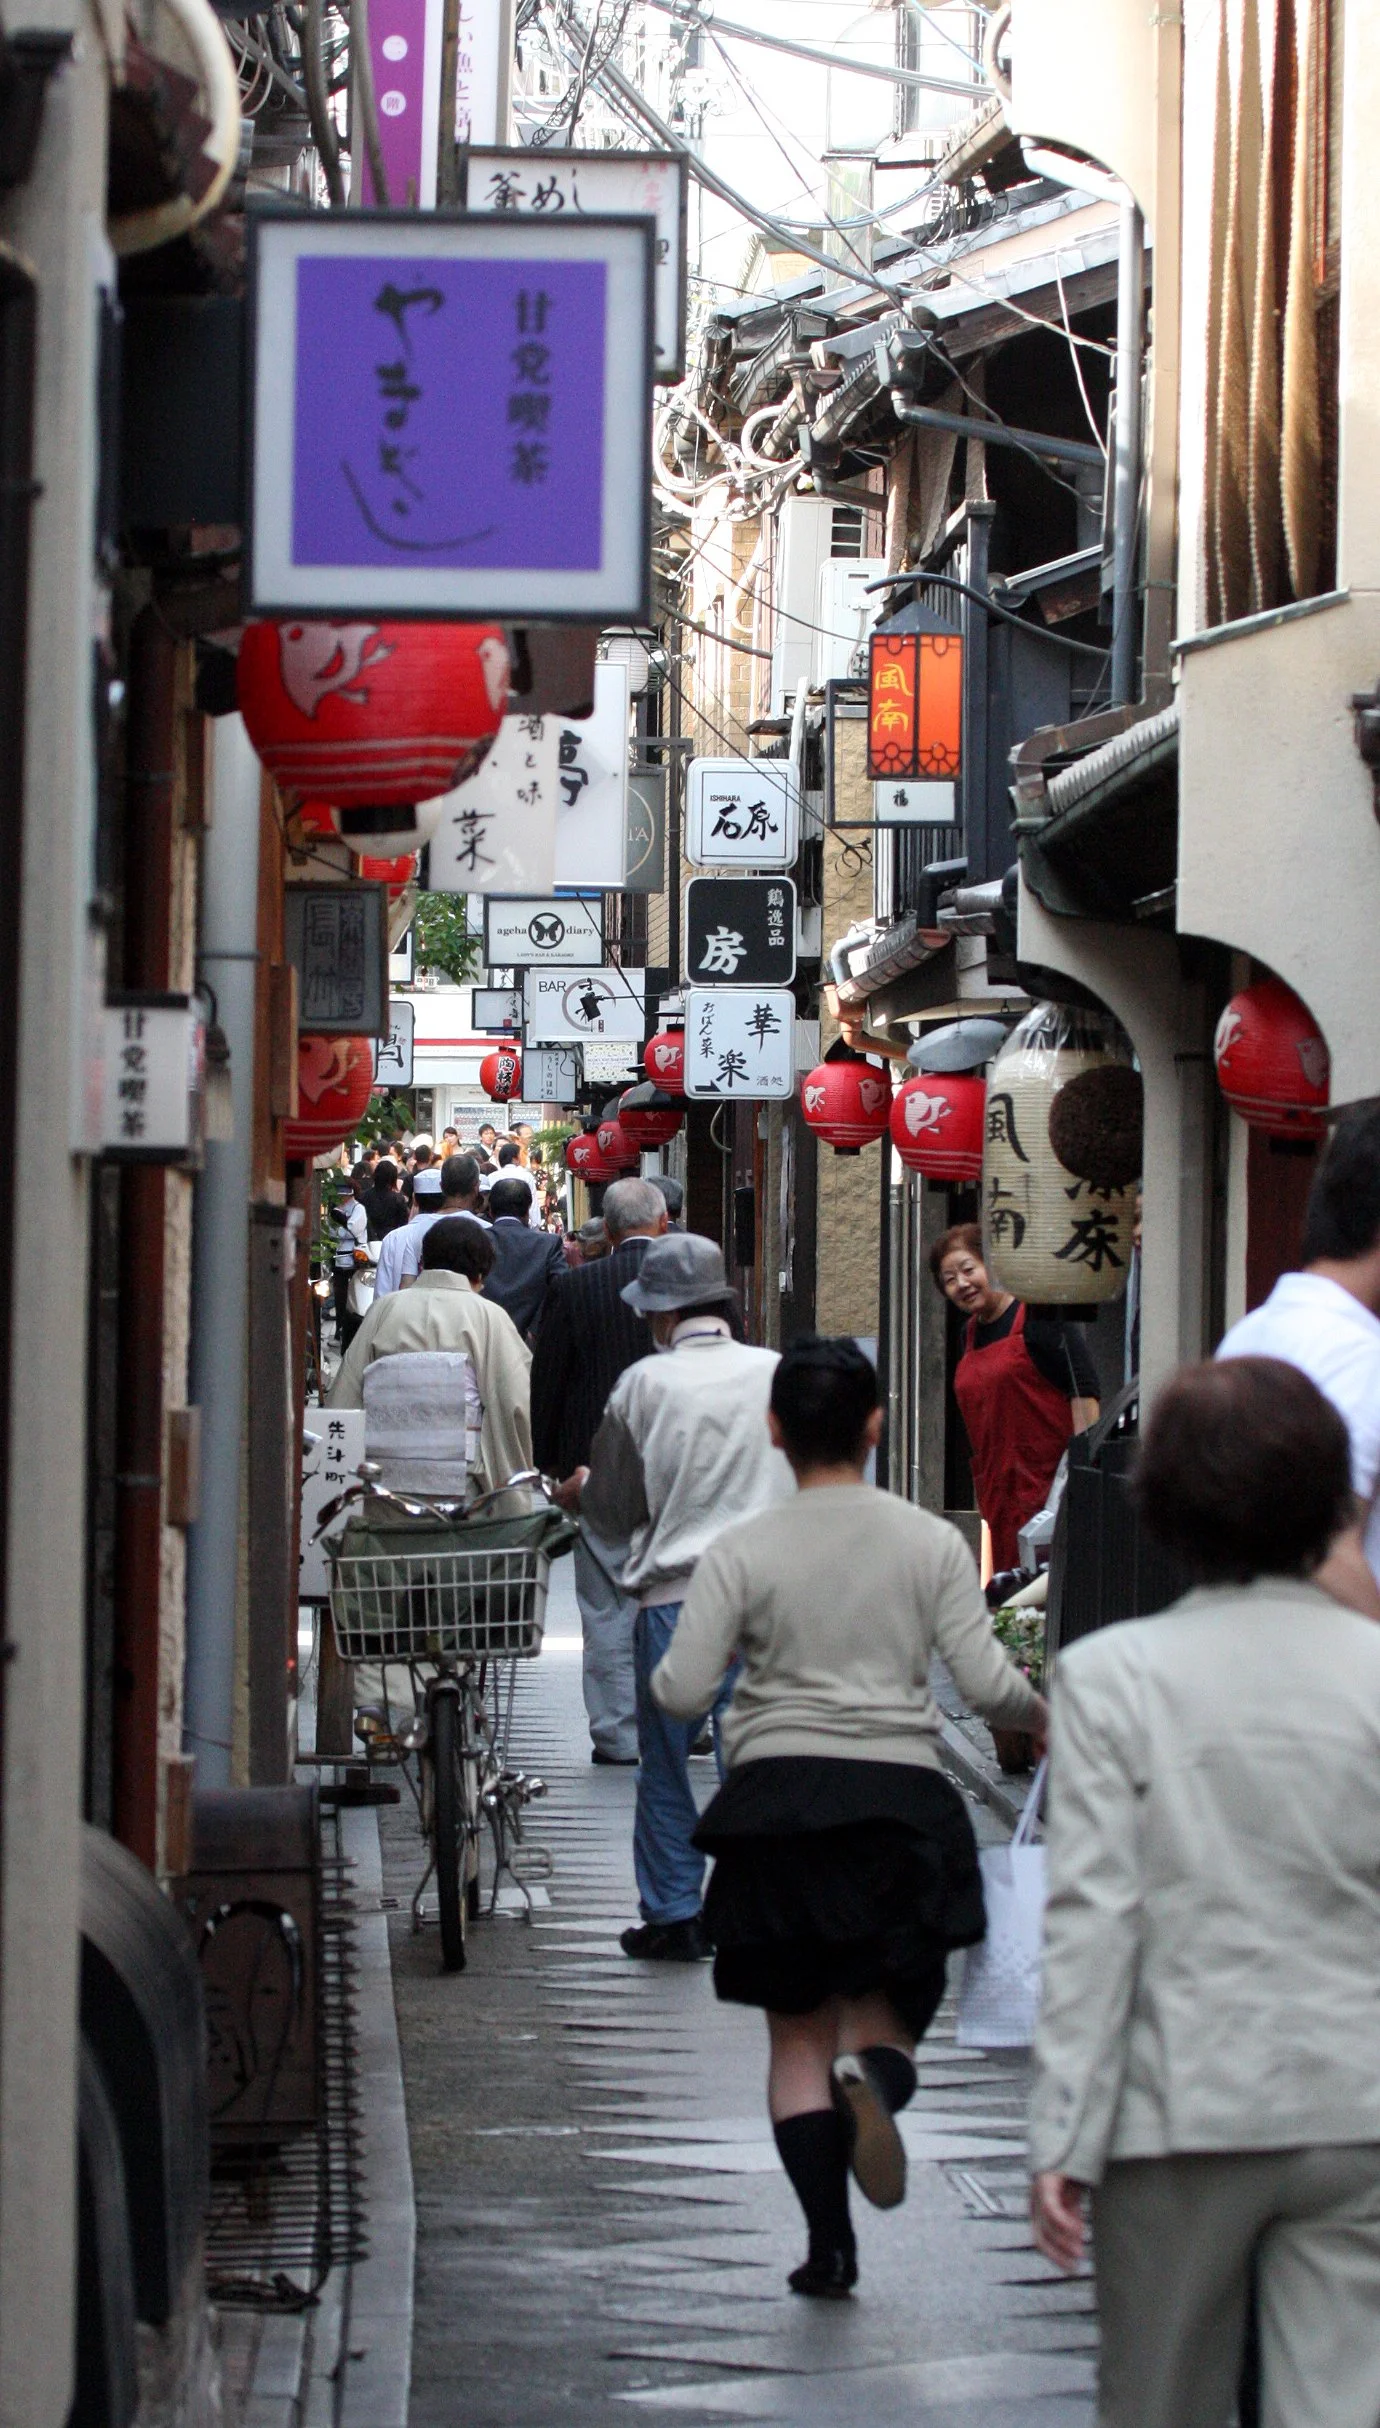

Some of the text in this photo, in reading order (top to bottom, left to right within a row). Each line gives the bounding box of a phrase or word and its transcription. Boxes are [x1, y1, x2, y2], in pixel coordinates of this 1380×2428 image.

[485, 168, 586, 214] 釜めし
[509, 289, 554, 486] 甘党喫茶
[872, 662, 914, 732] 風南
[711, 799, 779, 841] 石原
[497, 926, 595, 937] ageha diary
[698, 925, 748, 975] 房
[539, 980, 567, 993] BAR
[699, 1002, 716, 1059] おばん菜
[756, 1075, 784, 1087] 酒処
[987, 1092, 1031, 1250] 風南
[325, 1420, 346, 1485] 先斗町
